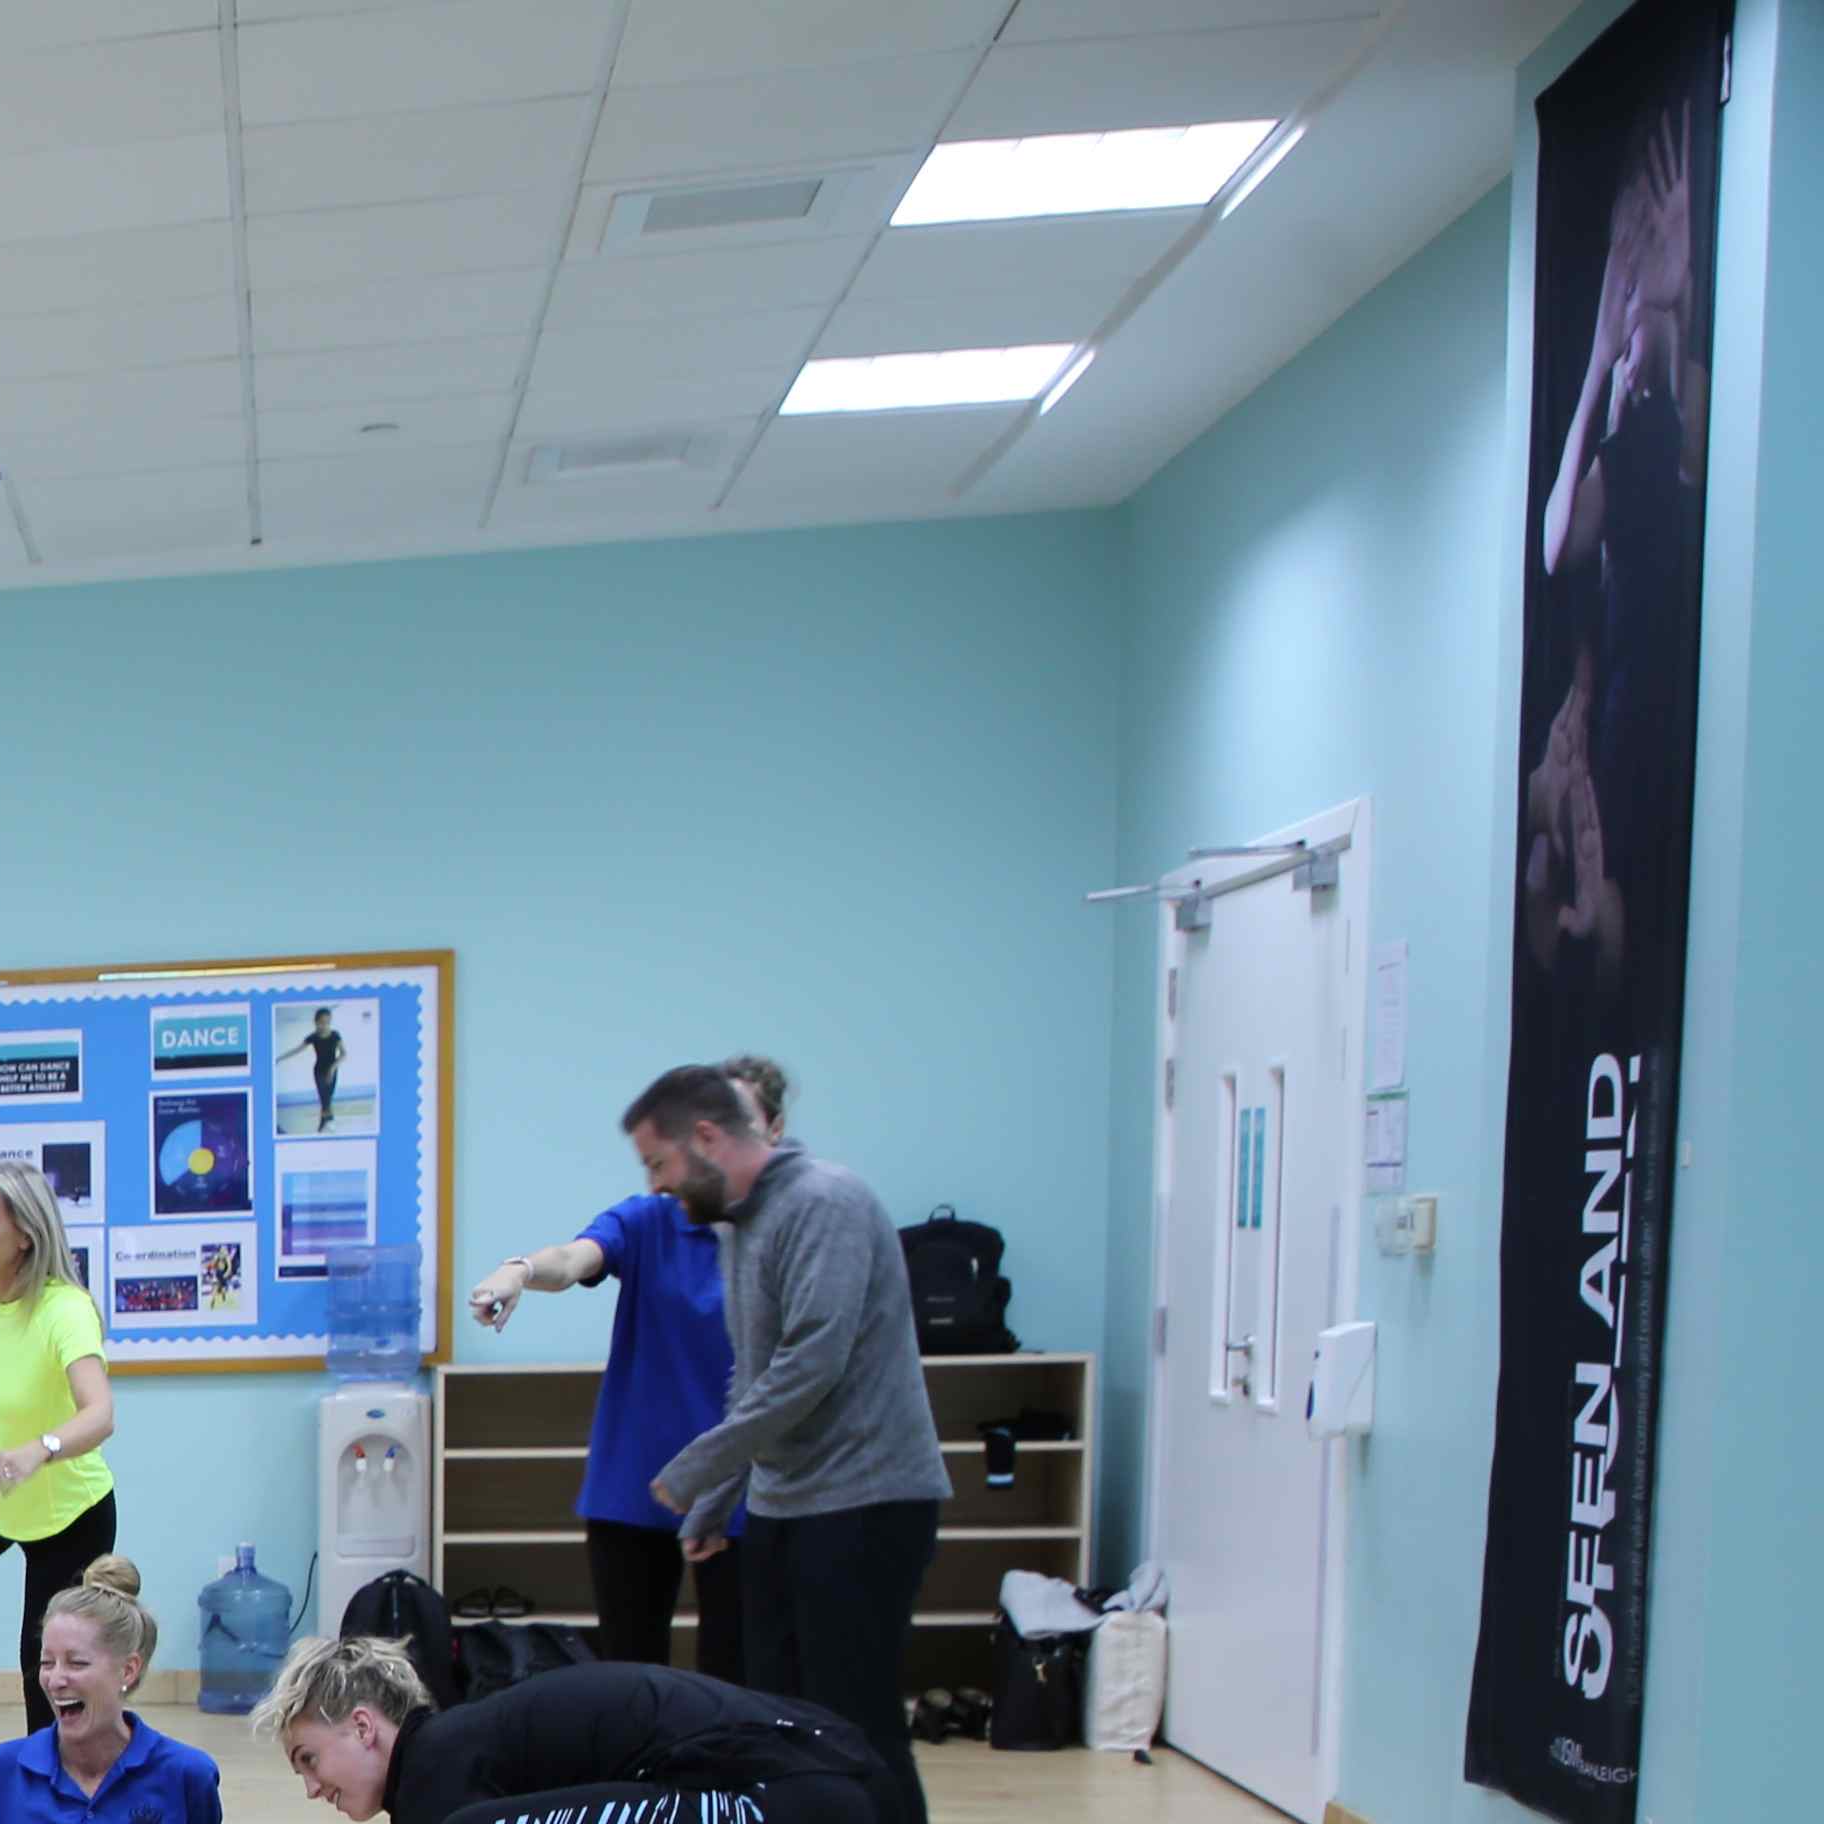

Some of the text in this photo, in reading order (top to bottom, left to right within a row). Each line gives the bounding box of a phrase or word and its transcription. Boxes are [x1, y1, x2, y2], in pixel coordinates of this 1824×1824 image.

[161, 1026, 239, 1049] DANCE
[18, 1062, 38, 1072] CAN
[40, 1060, 70, 1071] DANCE
[1579, 1052, 1627, 1328] AND
